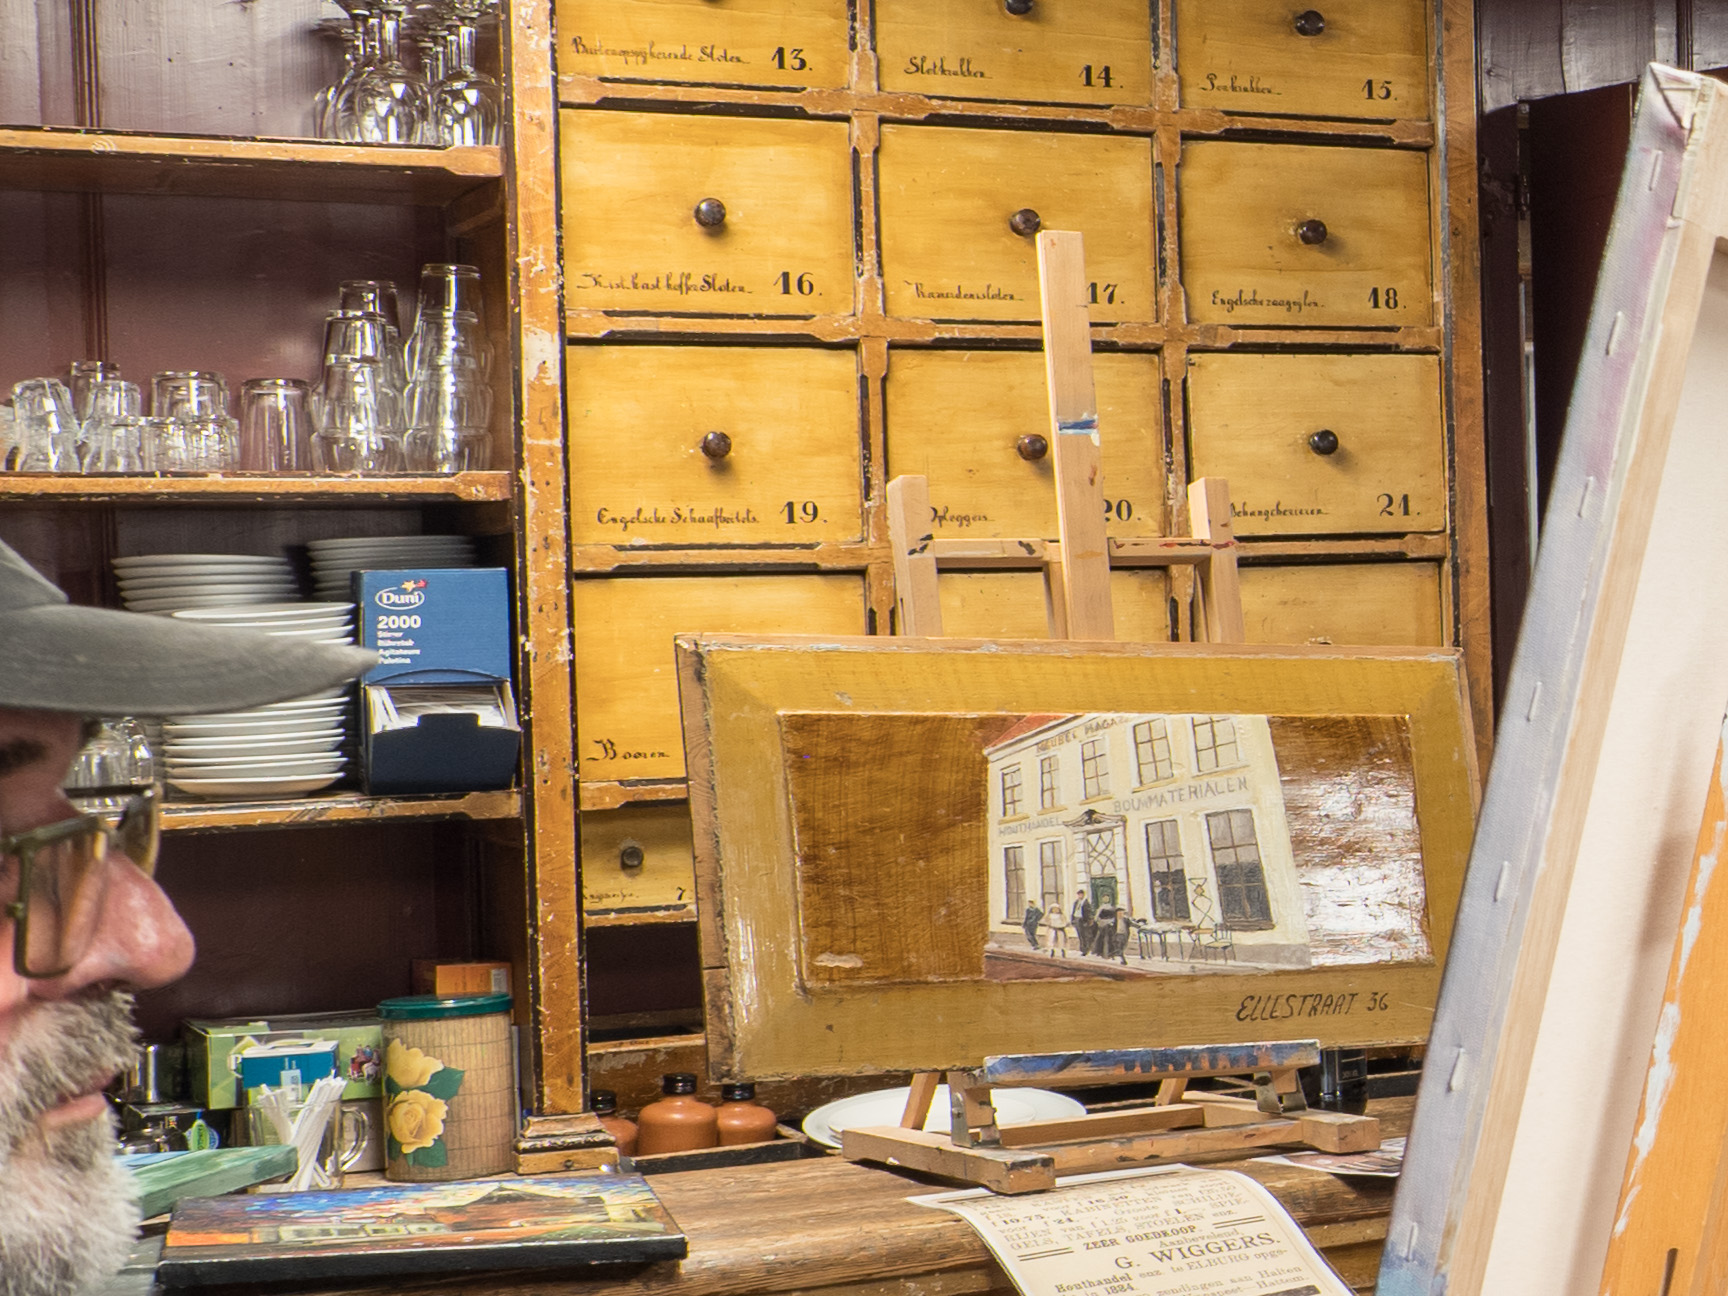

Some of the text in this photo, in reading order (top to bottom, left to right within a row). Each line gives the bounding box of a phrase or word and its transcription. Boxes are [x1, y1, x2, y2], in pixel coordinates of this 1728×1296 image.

[381, 591, 421, 605] Duni
[377, 615, 422, 629] 2000
[1235, 991, 1389, 1022] ELLESTRAAT 36
[1083, 1237, 1121, 1251] ZEER
[1114, 1232, 1281, 1269] G. WIGGERS.
